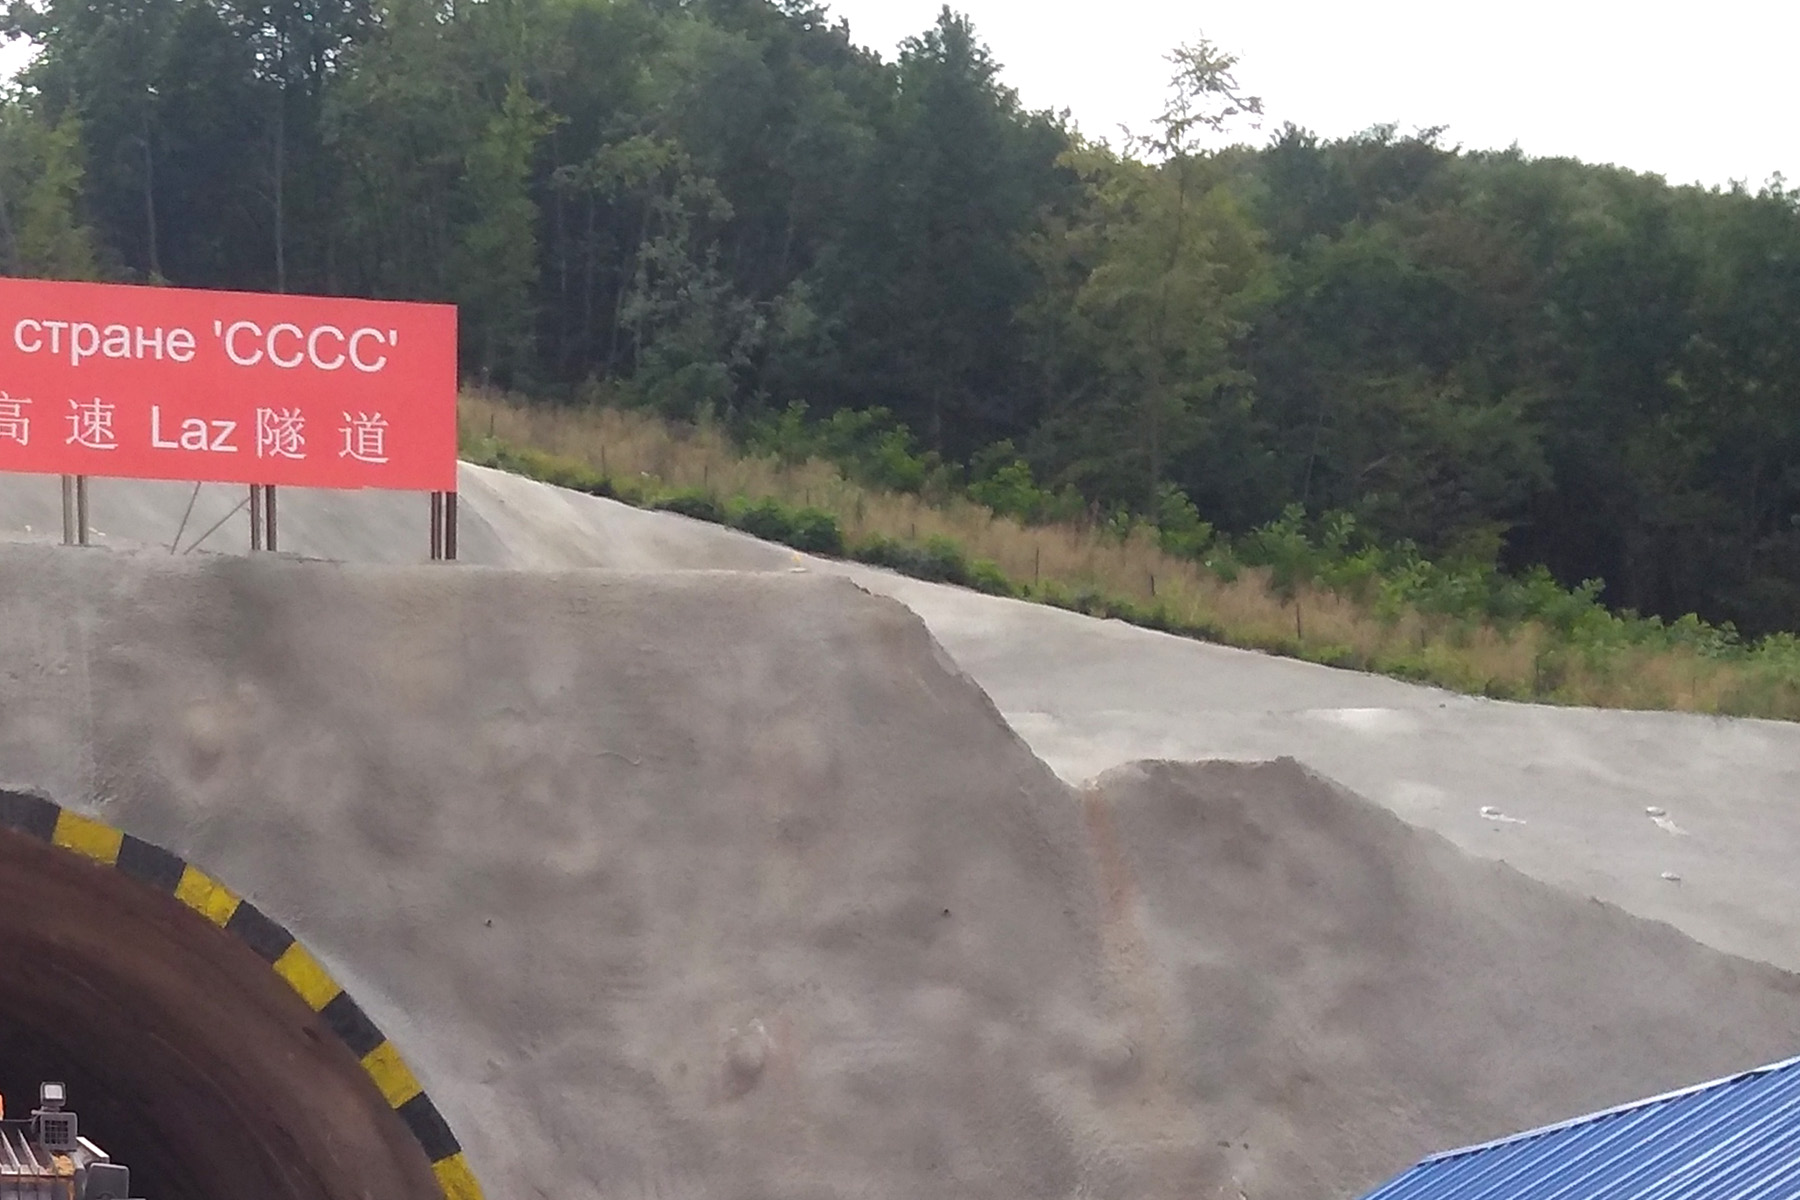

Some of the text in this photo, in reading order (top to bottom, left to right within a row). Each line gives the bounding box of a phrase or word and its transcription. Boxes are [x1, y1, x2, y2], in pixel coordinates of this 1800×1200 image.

[14, 319, 196, 366] стране
[151, 405, 238, 453] Laz
[256, 407, 390, 464] 隧道
